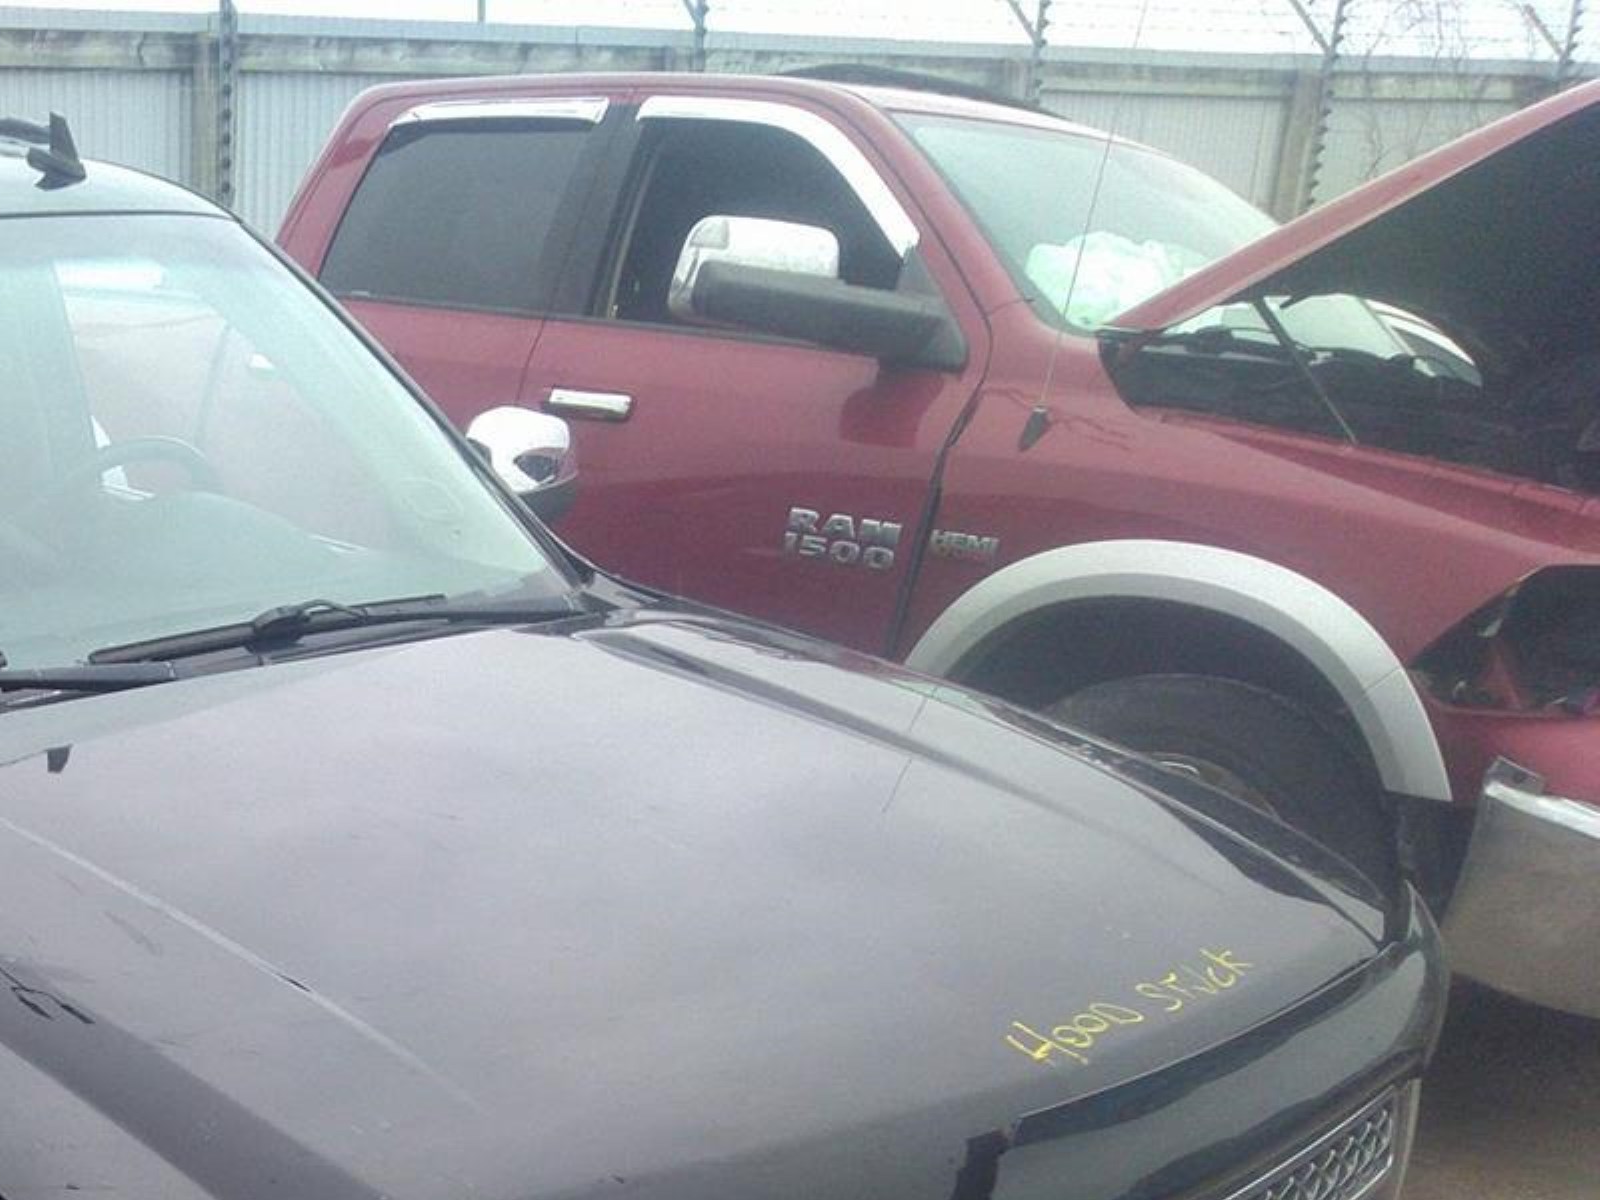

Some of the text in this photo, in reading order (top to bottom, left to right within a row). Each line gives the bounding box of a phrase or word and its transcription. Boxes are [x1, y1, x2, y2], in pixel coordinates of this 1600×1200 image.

[783, 531, 895, 570] 1500
[788, 506, 998, 558] RAM HEMI
